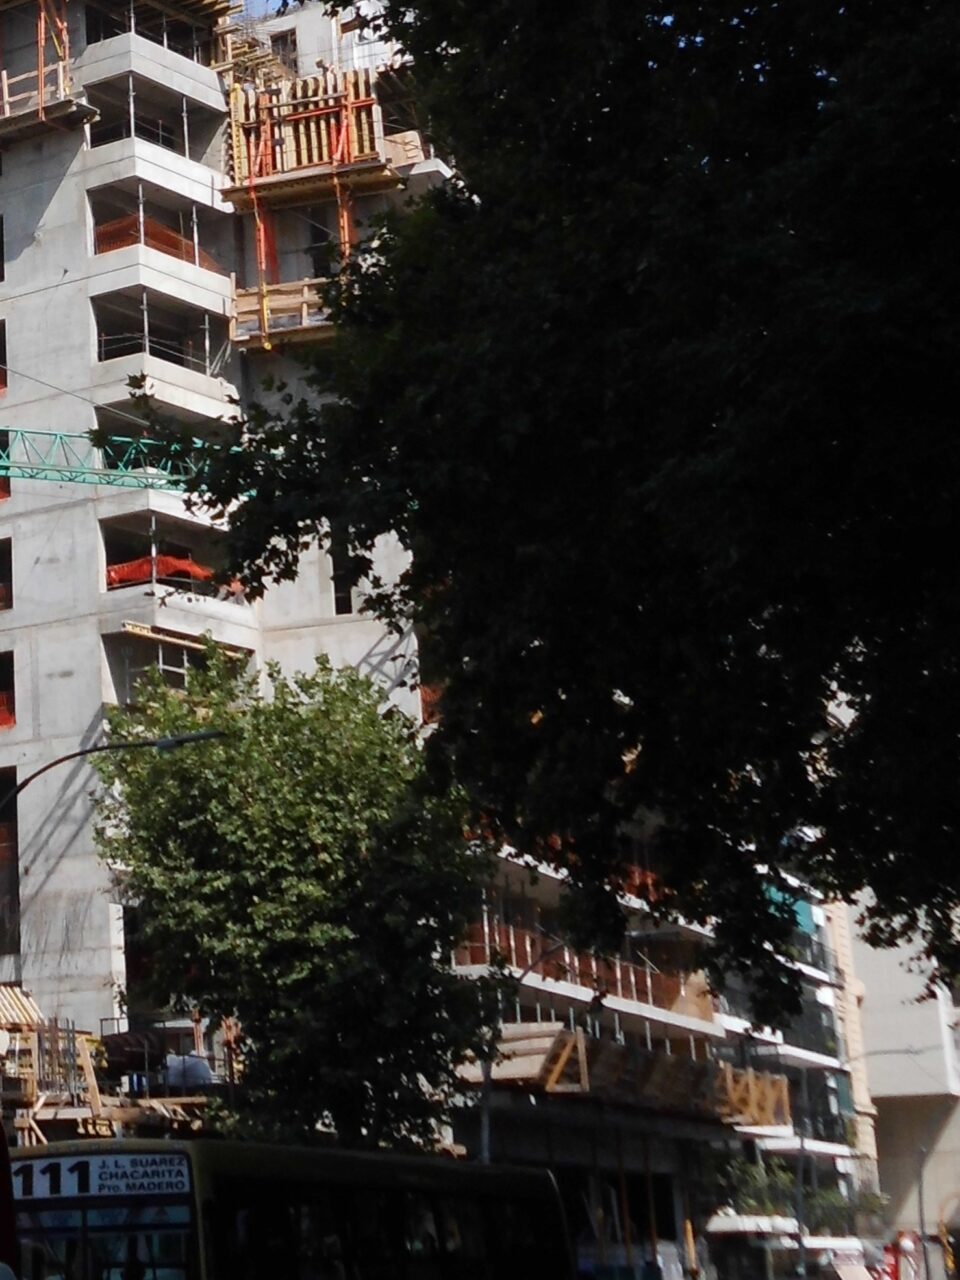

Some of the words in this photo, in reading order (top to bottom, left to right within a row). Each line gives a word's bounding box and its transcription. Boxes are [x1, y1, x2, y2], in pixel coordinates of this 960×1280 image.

[98, 1159, 110, 1170] J.
[114, 1159, 125, 1169] L.
[130, 1157, 185, 1169] SUAREZ
[13, 1160, 90, 1197] 111
[98, 1169, 185, 1182] CHACARITA
[125, 1180, 186, 1192] MADERO
